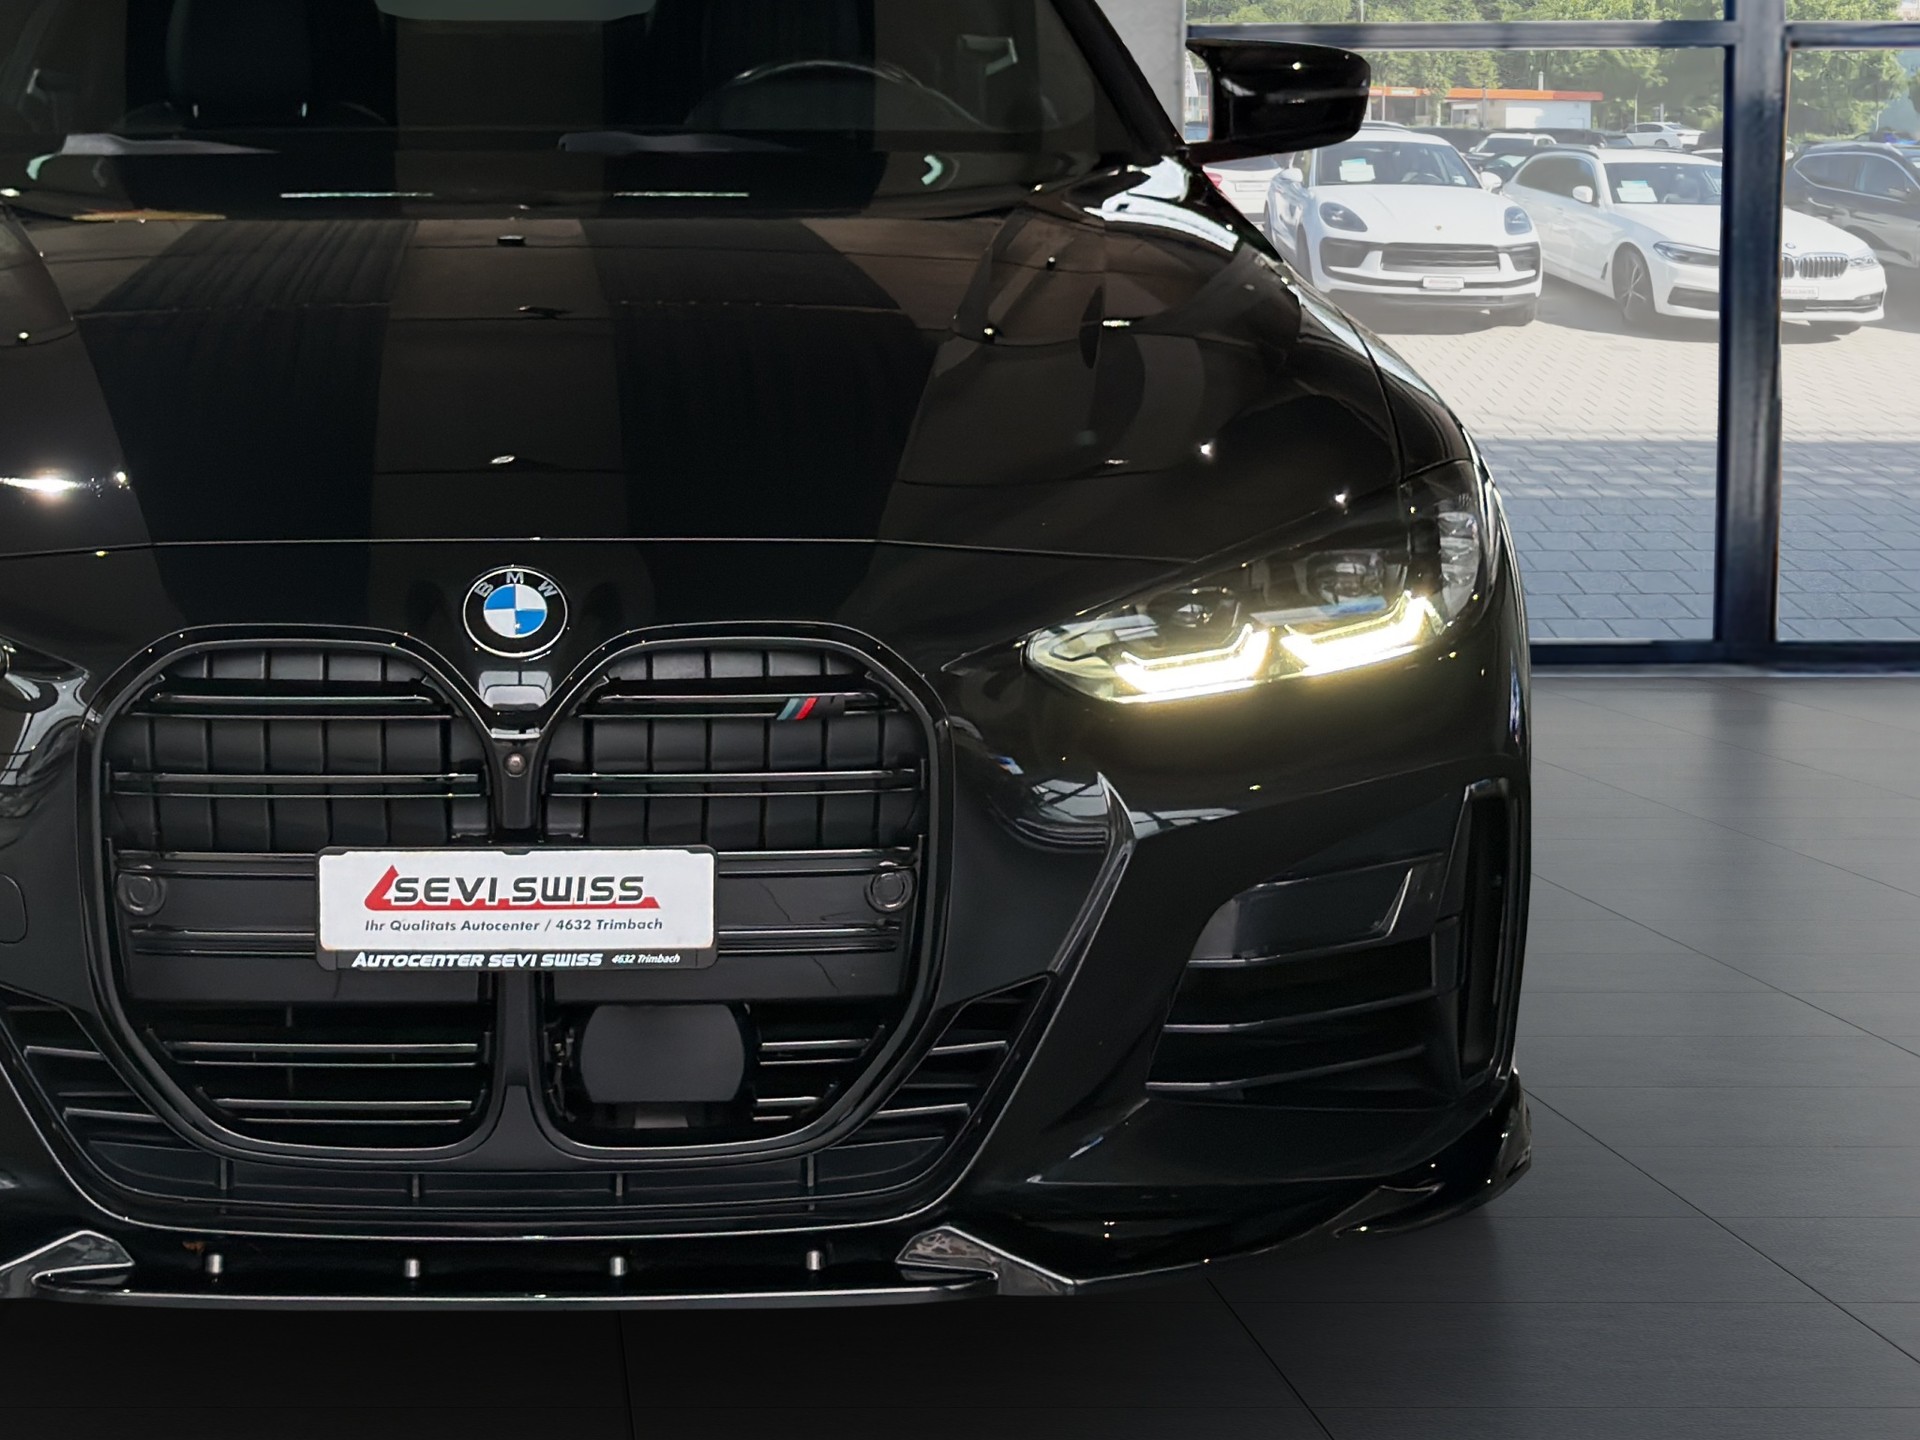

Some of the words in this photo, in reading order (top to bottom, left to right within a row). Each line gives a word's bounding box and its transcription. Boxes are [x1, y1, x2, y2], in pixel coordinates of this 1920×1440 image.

[474, 571, 558, 597] BMW
[393, 877, 498, 903] SEVI
[512, 876, 644, 902] SWISS
[365, 920, 386, 931] Ihr
[460, 919, 541, 931] Autocenter
[544, 919, 552, 932] /
[555, 919, 592, 931] 4632
[596, 918, 663, 930] Trimbach
[488, 953, 538, 968] SEVI
[540, 953, 604, 967] SWISS
[611, 954, 635, 964] 4632
[637, 953, 681, 964] Trimbach
